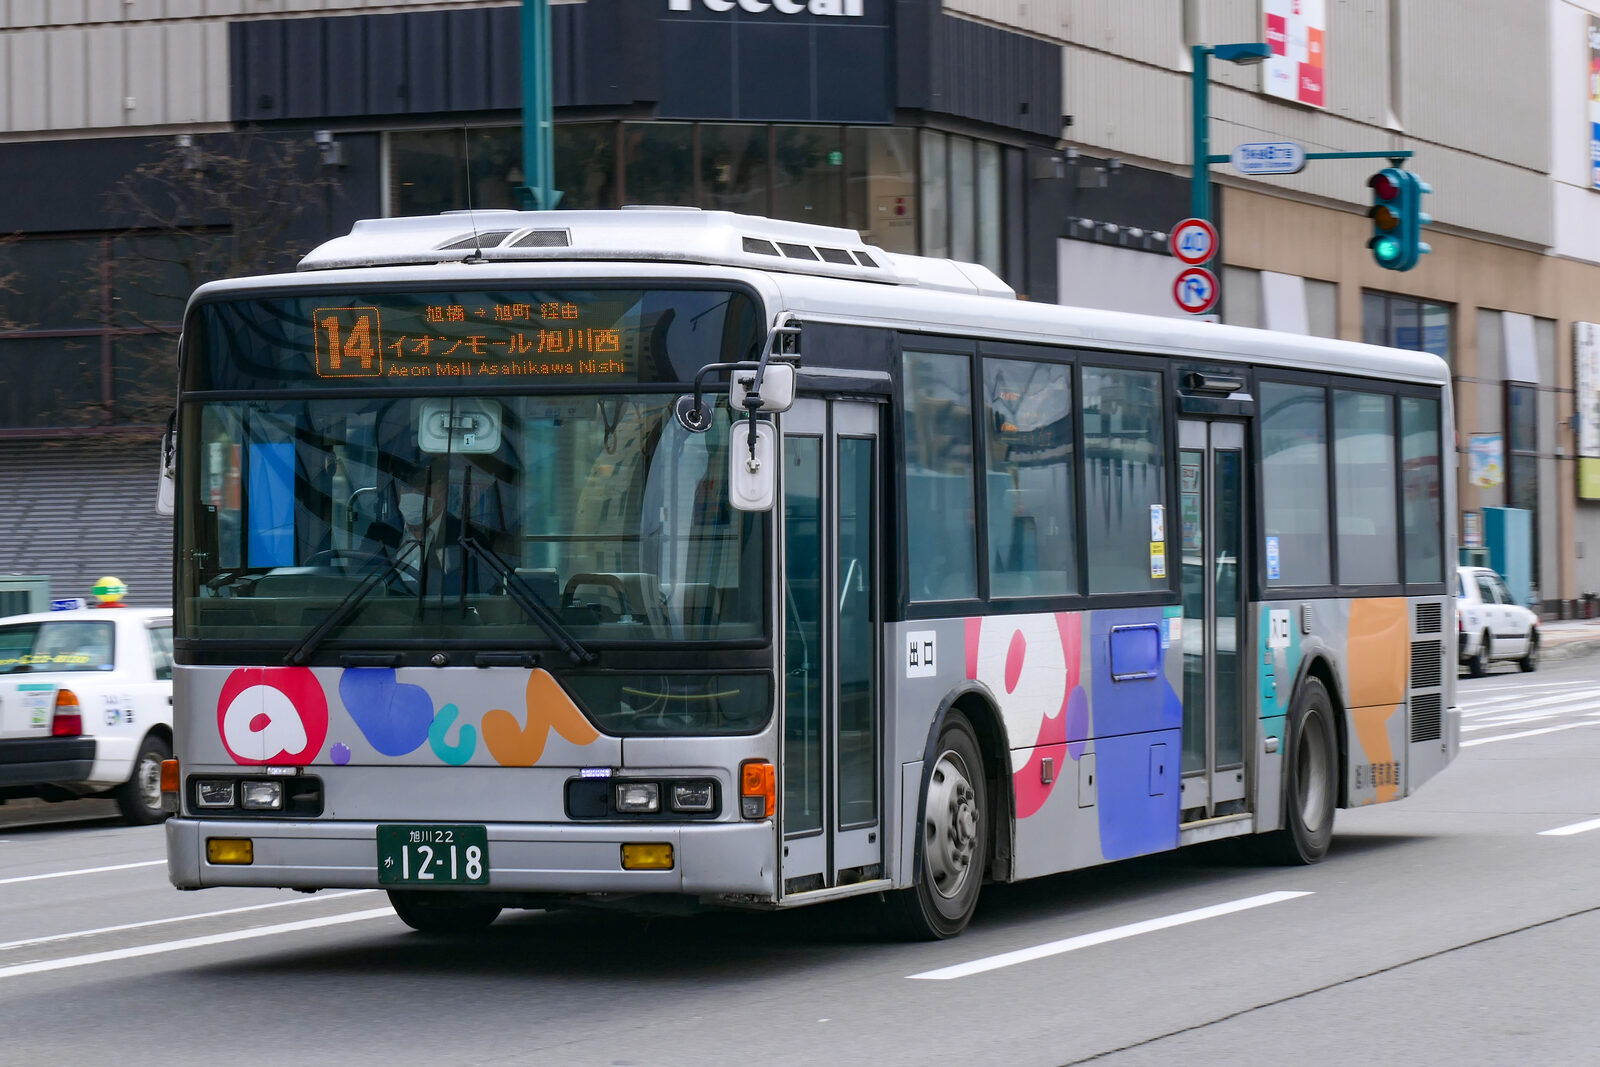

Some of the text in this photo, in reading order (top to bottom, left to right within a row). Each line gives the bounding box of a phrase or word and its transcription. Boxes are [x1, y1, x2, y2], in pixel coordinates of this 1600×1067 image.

[1181, 232, 1209, 251] 40
[426, 301, 578, 323] 旭橋 旭町 経由
[321, 315, 374, 369] 14
[387, 328, 620, 358] イオンモール旭川西
[388, 359, 625, 376] Aeon Mall Asahikawa Nishi
[909, 641, 933, 667] 出口
[384, 845, 482, 880] か 12-18
